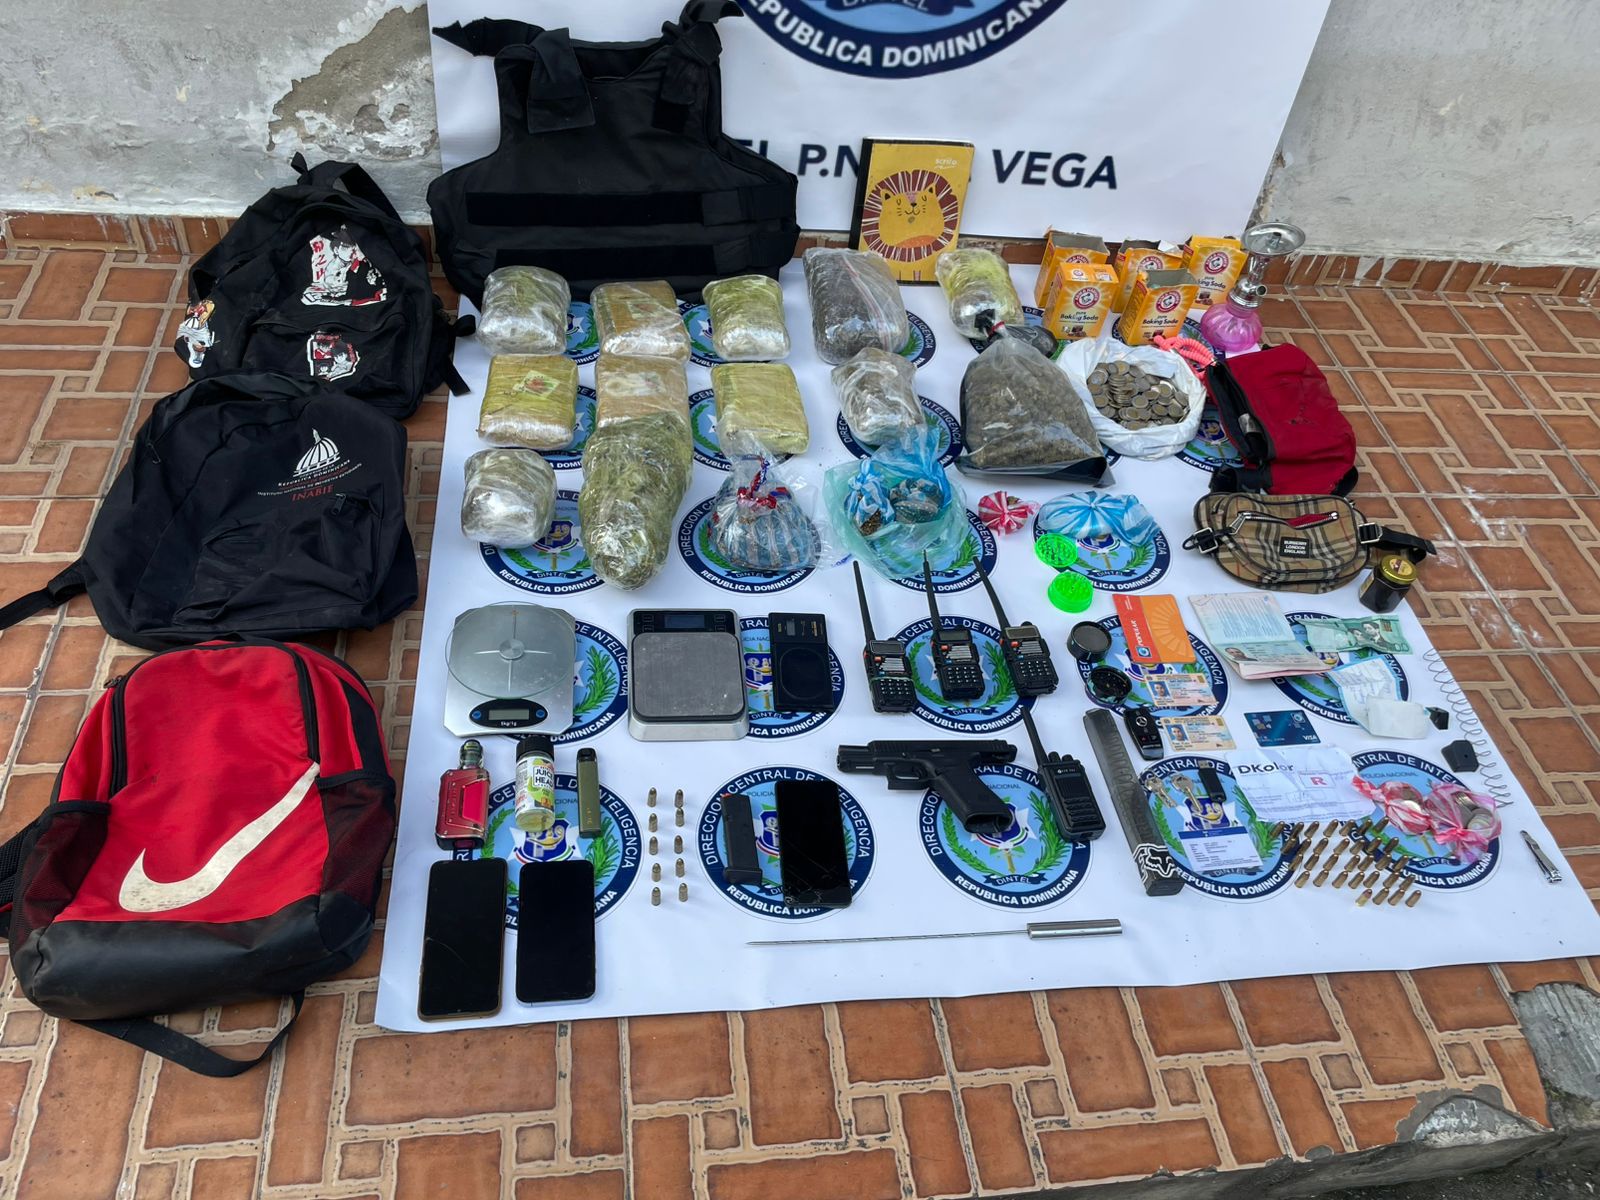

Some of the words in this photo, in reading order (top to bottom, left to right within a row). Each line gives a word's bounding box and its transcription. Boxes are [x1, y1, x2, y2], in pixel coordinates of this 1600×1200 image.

[747, 0, 873, 67] EPUBLICA
[882, 0, 1049, 68] DOMINICAN
[992, 149, 1118, 190] VEGA
[292, 485, 334, 501] INABIE
[679, 508, 704, 557] DIRECCION
[499, 568, 551, 593] REPUBLICA
[701, 569, 752, 592] REPUBLICA
[754, 569, 807, 592] DOMINICANA
[1116, 567, 1162, 590] DOMINICANA
[963, 621, 981, 632] DE
[916, 705, 972, 731] REPUBLICA
[1299, 698, 1352, 722] REPUBLIC
[549, 711, 616, 743] DOMINICANA
[1003, 765, 1025, 776] DE
[1237, 762, 1294, 775] DKolor
[1352, 753, 1395, 769] NTRAL
[1397, 755, 1417, 766] DE
[727, 769, 791, 793] CENTRAL
[1310, 776, 1328, 786] R
[599, 788, 639, 869] NTELIGENCIA
[996, 875, 1031, 886] DINTEL
[1175, 867, 1238, 896] REPUBLICA
[1239, 860, 1290, 896] DOMINICANA
[1447, 852, 1493, 886] DOMINICANA
[954, 874, 1019, 905] REPUBLICA
[1020, 869, 1079, 905] DOMINICANA
[726, 885, 790, 916] REPUBLICA
